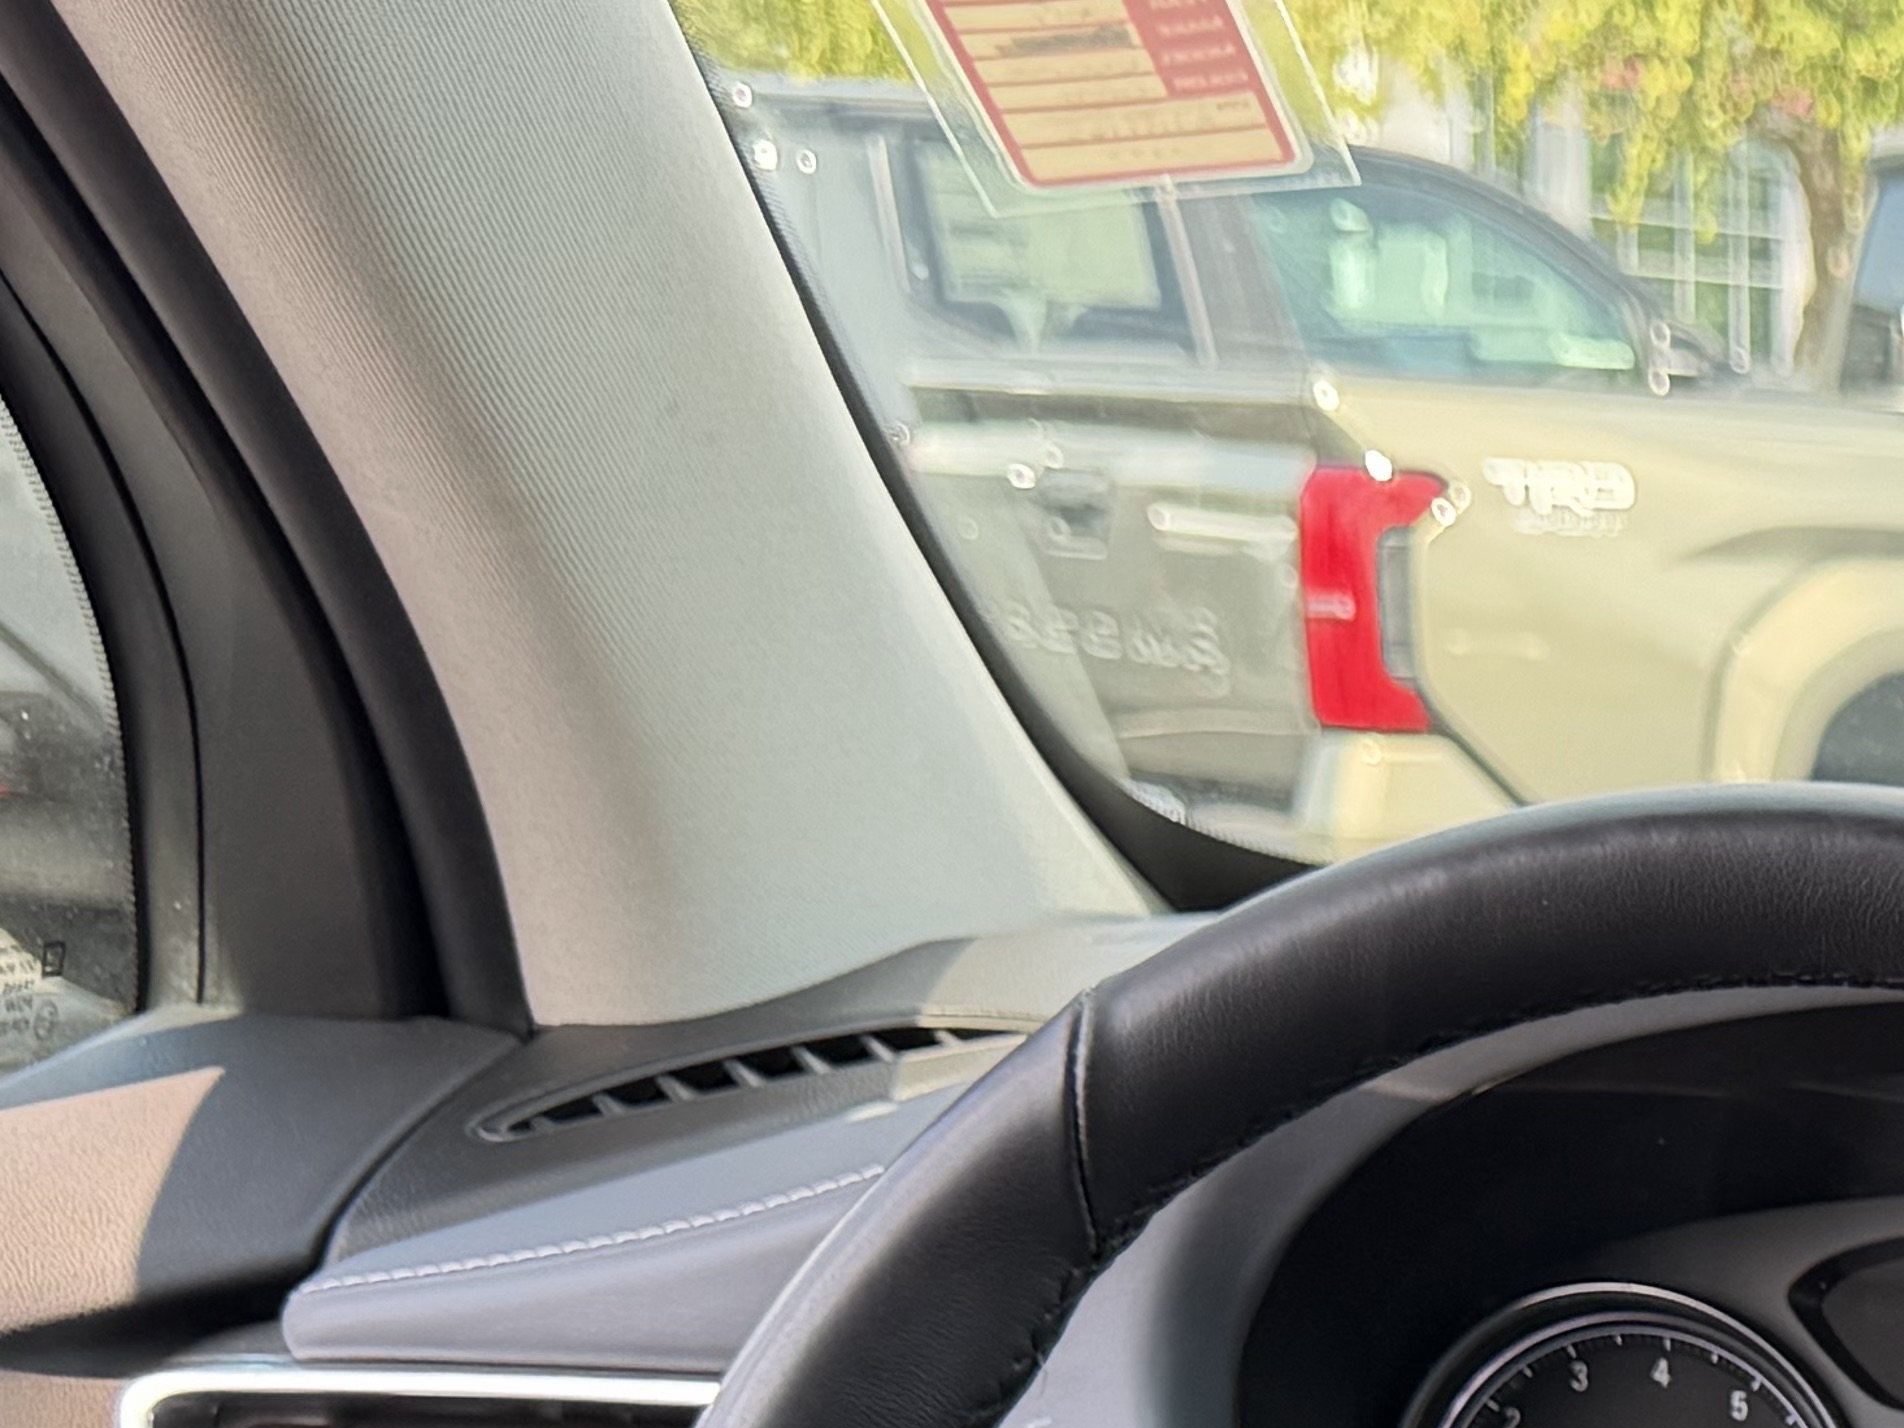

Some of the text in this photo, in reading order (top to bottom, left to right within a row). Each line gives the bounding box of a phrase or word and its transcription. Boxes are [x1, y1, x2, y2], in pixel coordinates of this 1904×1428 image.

[1570, 1361, 1589, 1392] 3
[1651, 1358, 1671, 1389] 4
[1730, 1391, 1748, 1422] 5
